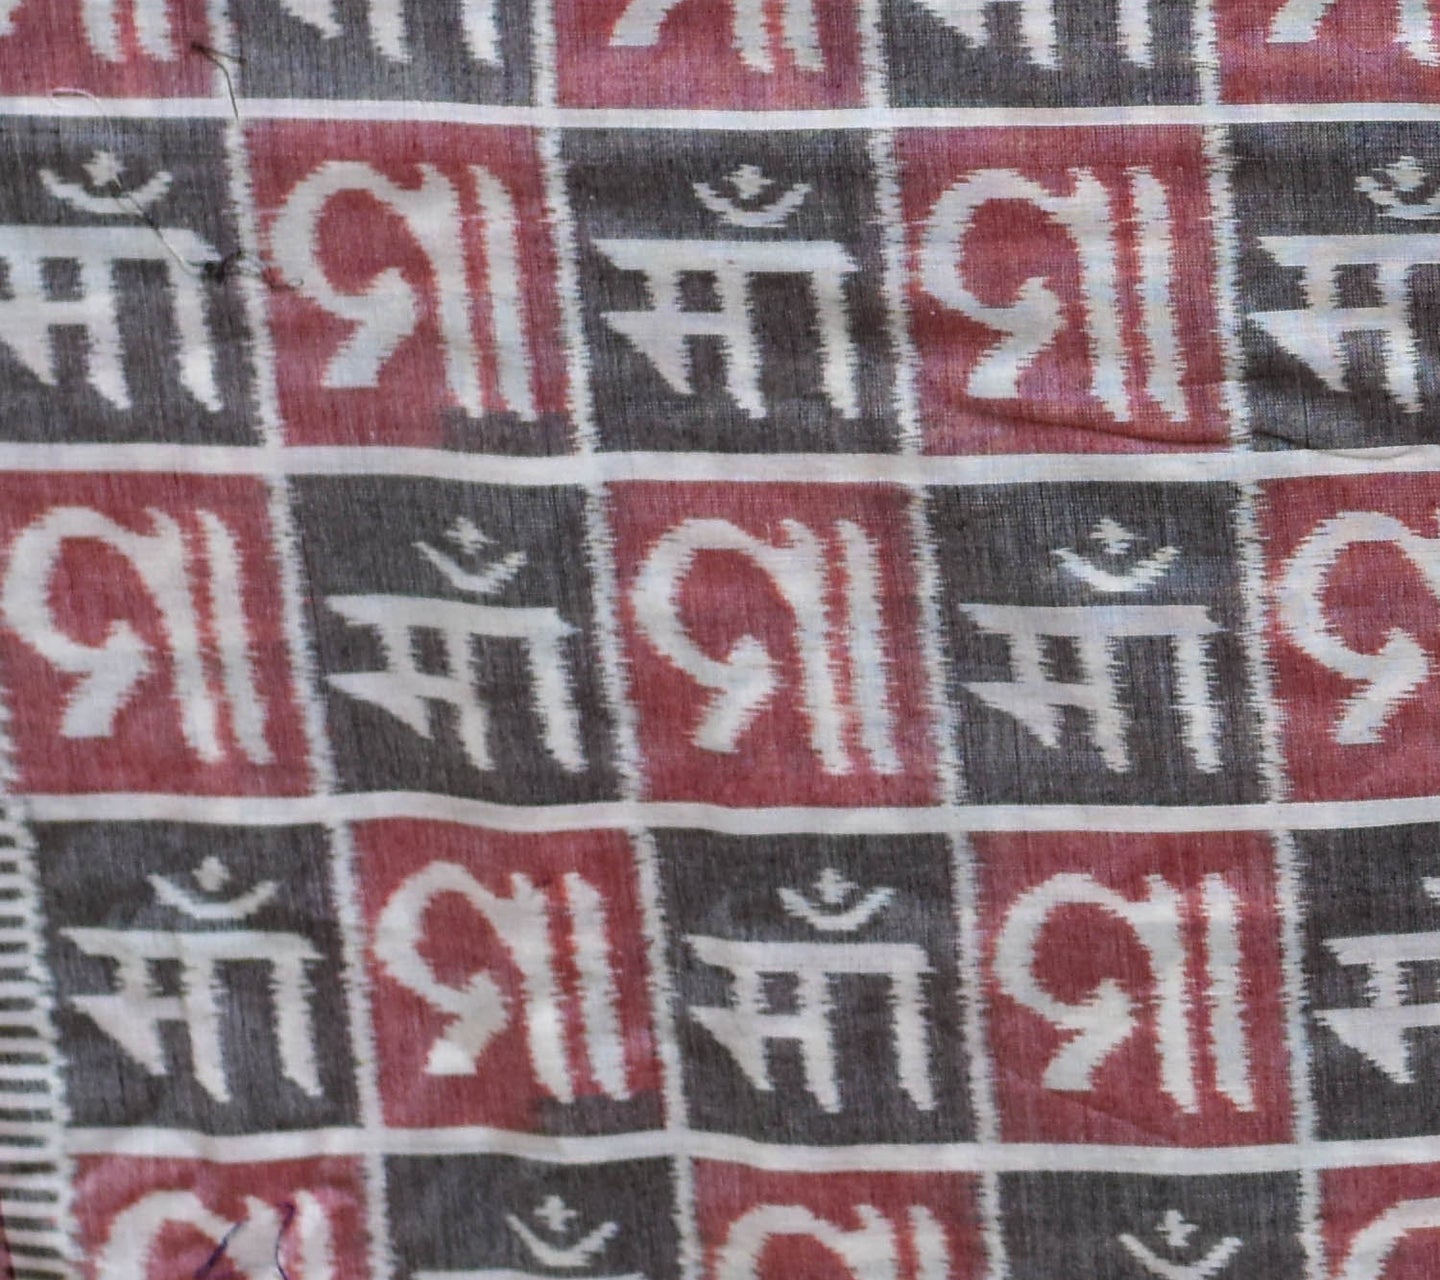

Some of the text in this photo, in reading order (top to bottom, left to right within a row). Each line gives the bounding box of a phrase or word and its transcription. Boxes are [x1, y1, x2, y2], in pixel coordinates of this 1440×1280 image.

[0, 151, 223, 412] माँ
[593, 166, 860, 419] माँ
[327, 519, 585, 772] माँ
[962, 519, 1220, 773] माँ
[58, 855, 325, 1105] माँ
